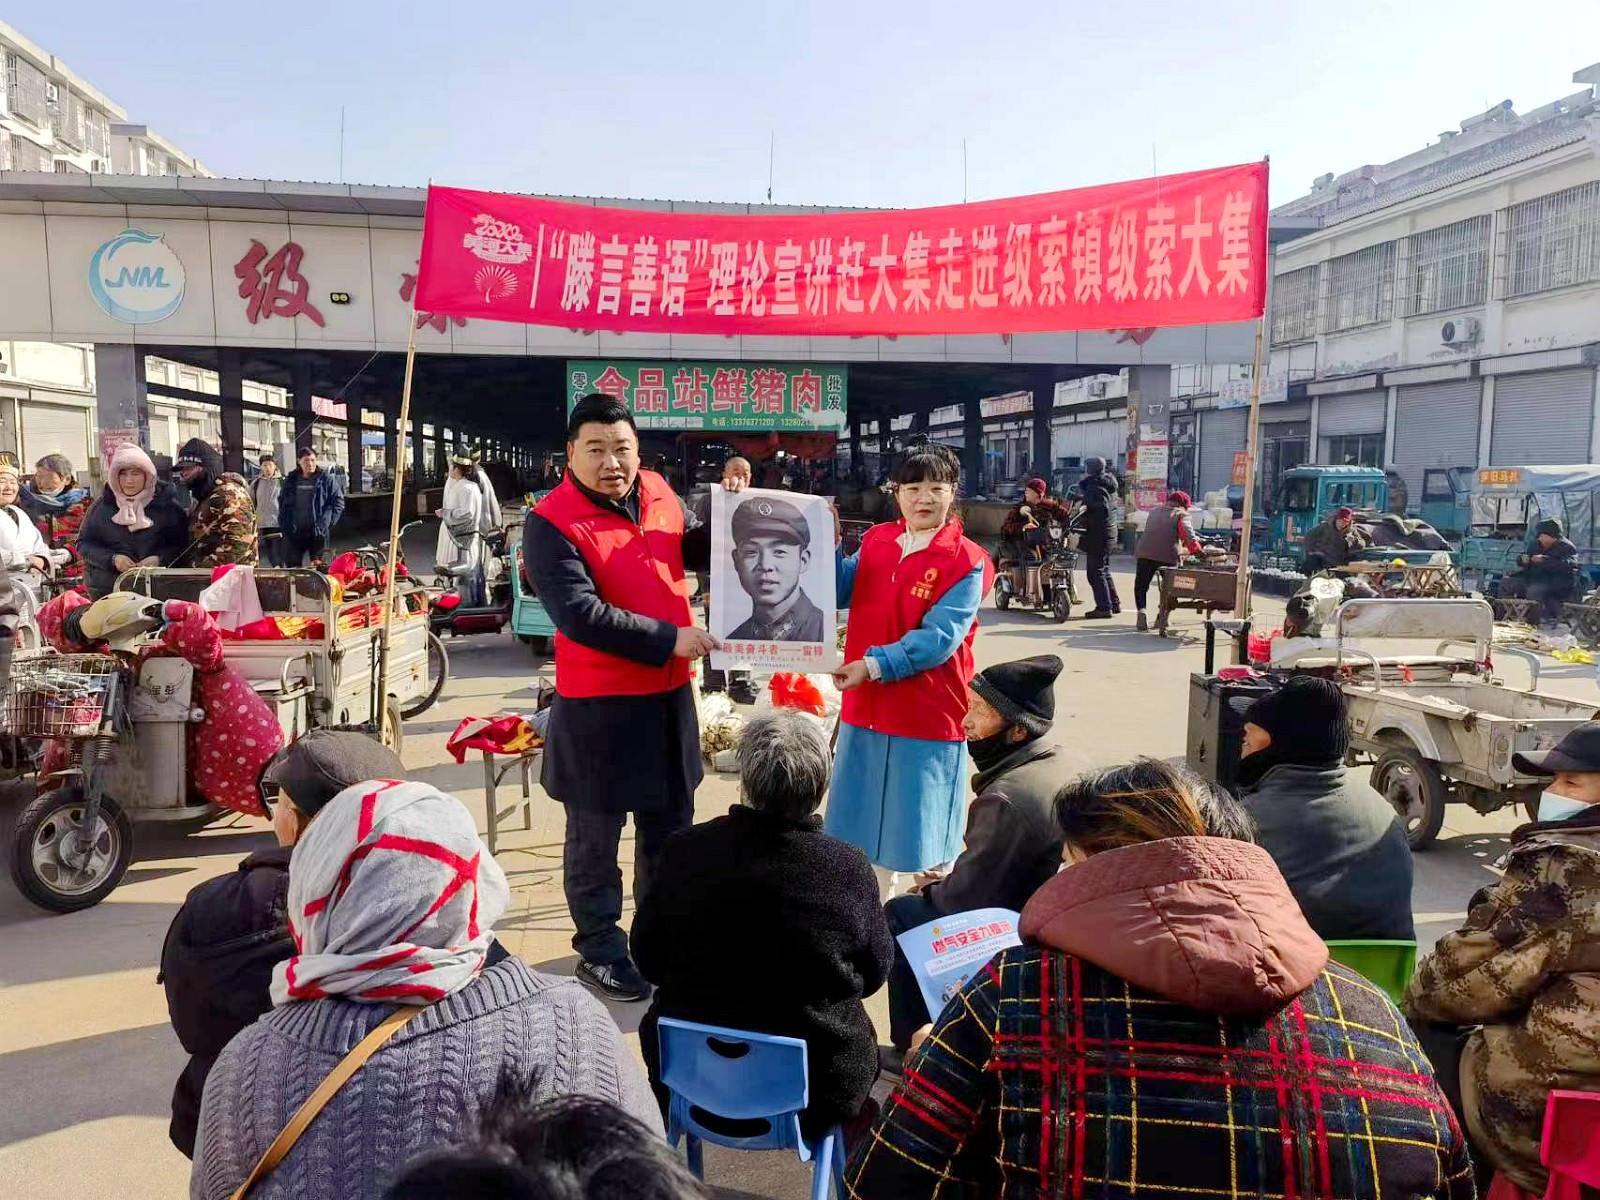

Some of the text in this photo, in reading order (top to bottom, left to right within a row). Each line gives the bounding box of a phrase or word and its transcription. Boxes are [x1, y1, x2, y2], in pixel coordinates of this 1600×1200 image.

[592, 366, 822, 414] 食品站鲜猪肉
[827, 374, 843, 410] 批发
